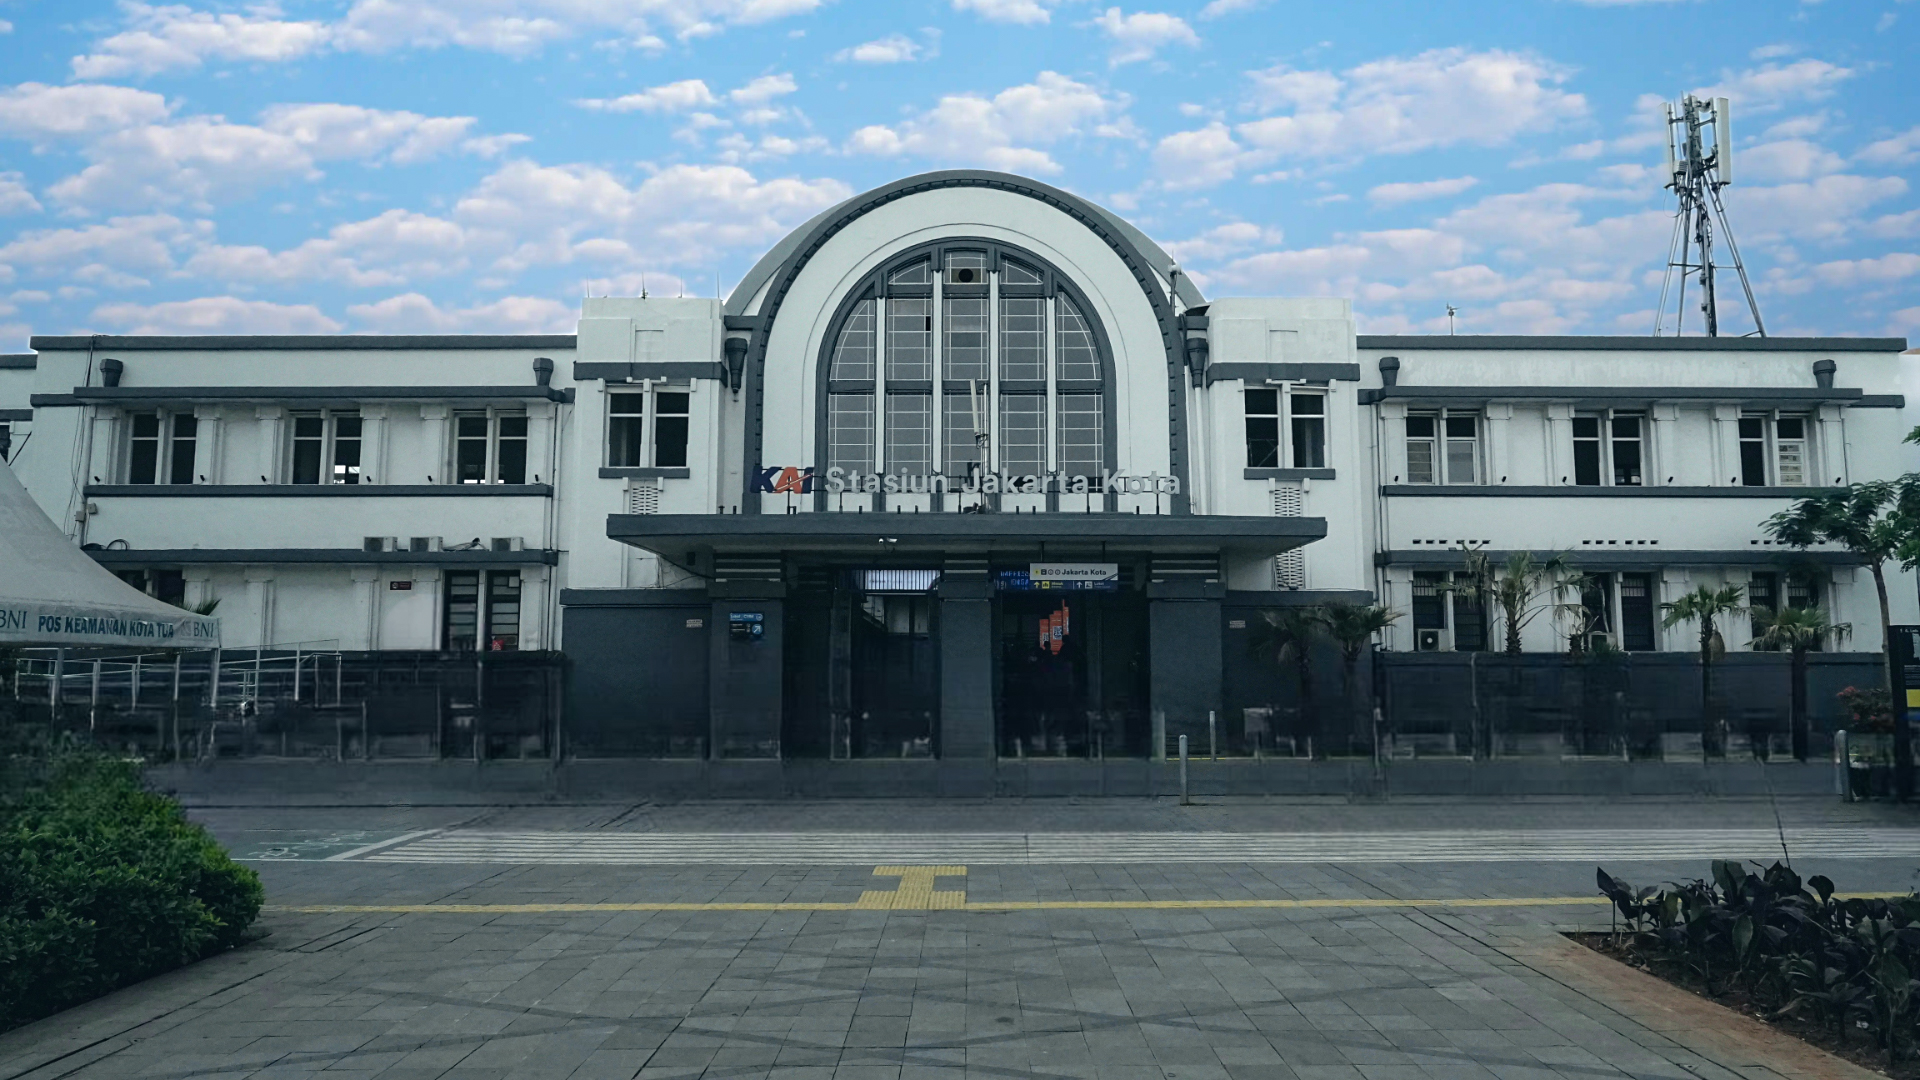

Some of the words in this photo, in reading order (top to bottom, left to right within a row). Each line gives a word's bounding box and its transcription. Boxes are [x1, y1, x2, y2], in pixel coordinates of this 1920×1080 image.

[750, 466, 814, 495] KAI
[825, 466, 949, 494] Stasiun
[962, 467, 1089, 495] Jakarta
[1102, 468, 1181, 495] Kota
[1061, 568, 1089, 576] Jakarta
[1090, 568, 1107, 576] Kota
[0, 609, 28, 630] BNI
[38, 615, 62, 633] POS
[64, 616, 127, 637] KEAMANAN
[129, 620, 155, 638] KOTA
[157, 623, 174, 639] TUA
[193, 621, 214, 638] BNI
